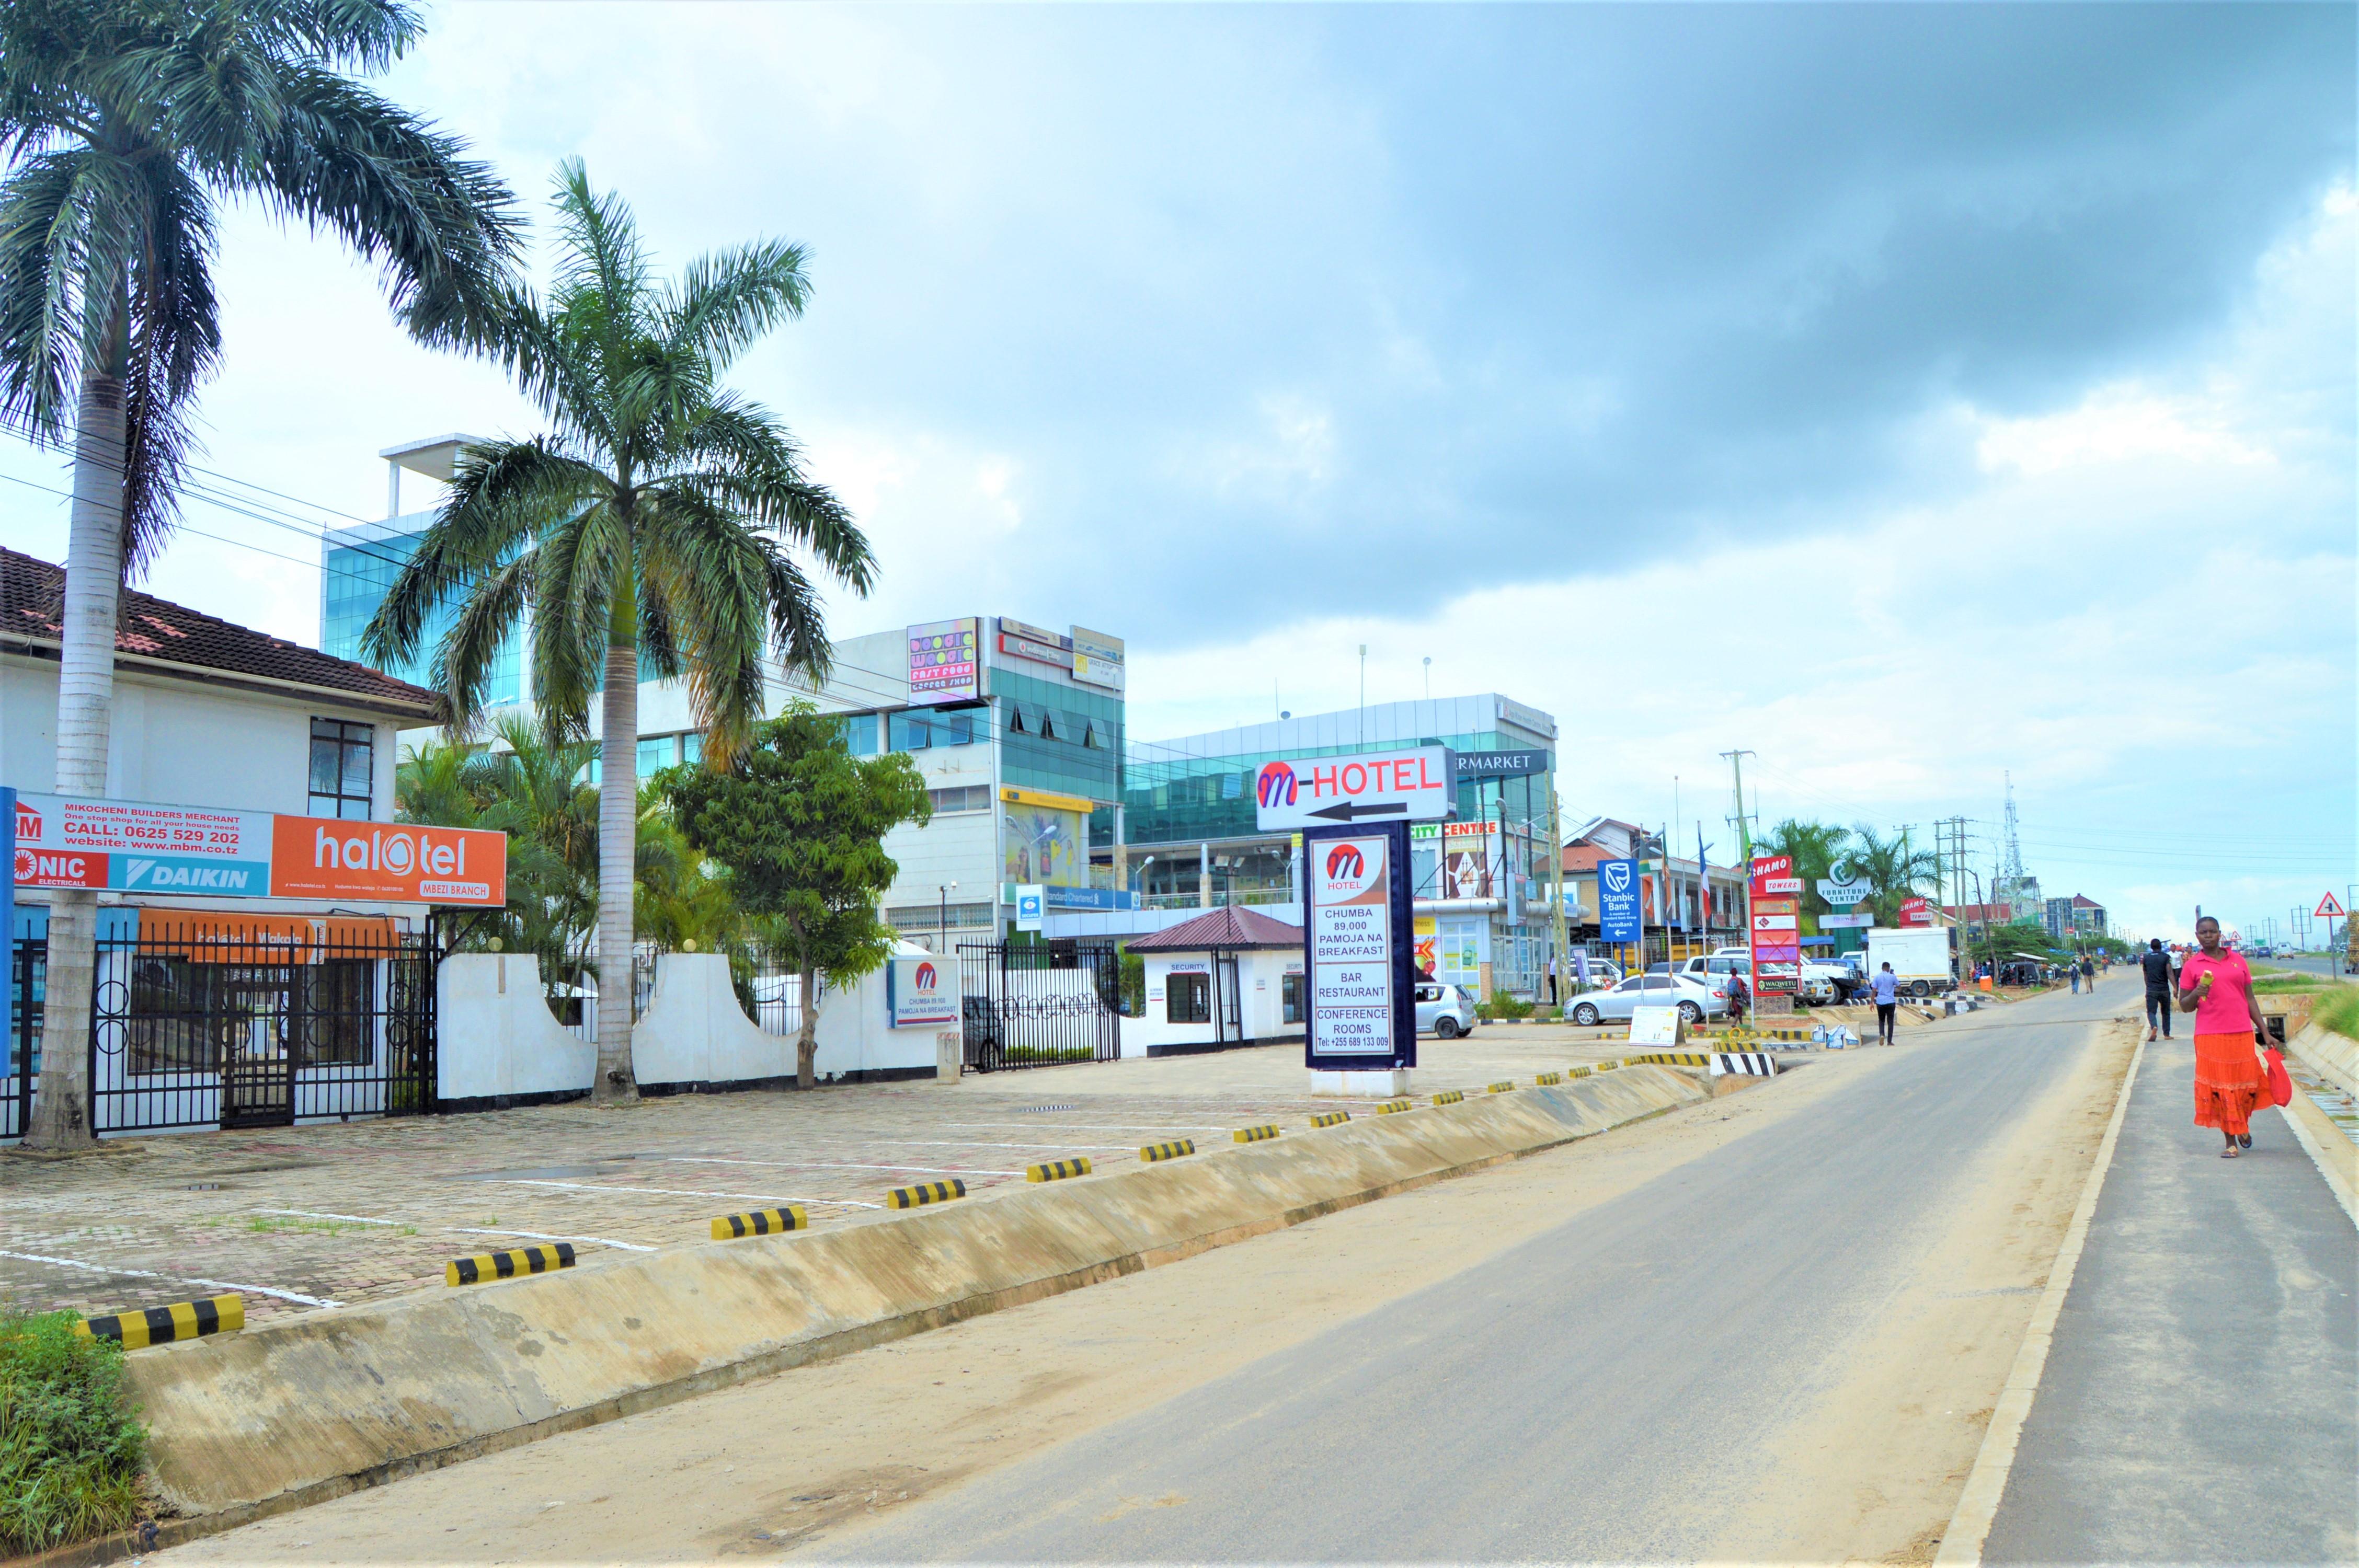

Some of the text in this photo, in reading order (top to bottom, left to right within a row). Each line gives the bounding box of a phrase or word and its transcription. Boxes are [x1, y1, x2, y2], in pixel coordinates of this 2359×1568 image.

[65, 803, 241, 824] MIKOCHENI BUILDERS MERCHANT
[109, 816, 133, 824] shop
[15, 816, 42, 838] M
[1445, 822, 1496, 836] CENTRE
[64, 822, 239, 844] CALL: 0625 529 202
[64, 837, 238, 855] website: www.mbm.co.tz
[315, 826, 465, 876] halotel
[1753, 858, 1787, 877] SHAMO
[39, 879, 86, 887] ELECTRICALS
[152, 867, 248, 889] DAIKIN
[423, 884, 448, 894] MBEZI
[451, 885, 486, 896] BRANCH
[1328, 881, 1362, 890] HOTEL
[1822, 887, 1867, 896] FURNITURE
[1068, 892, 1094, 903] Chartered
[1603, 892, 1635, 903] Stanbic
[1608, 902, 1630, 911] Bank
[1900, 899, 1924, 912] SHAMO
[1325, 908, 1373, 918] CHUMBA
[1334, 921, 1367, 931] 89,000
[1320, 933, 1383, 943] PAMOJA NA
[1319, 946, 1384, 956] BREAKFAST
[1341, 973, 1362, 982] BAR
[1319, 987, 1385, 997] RESTAURANT
[1317, 1009, 1388, 1019] CONFERENCE
[1333, 1024, 1371, 1034] ROOMS
[1318, 1036, 1389, 1046] Tel: +255 689 133 009
